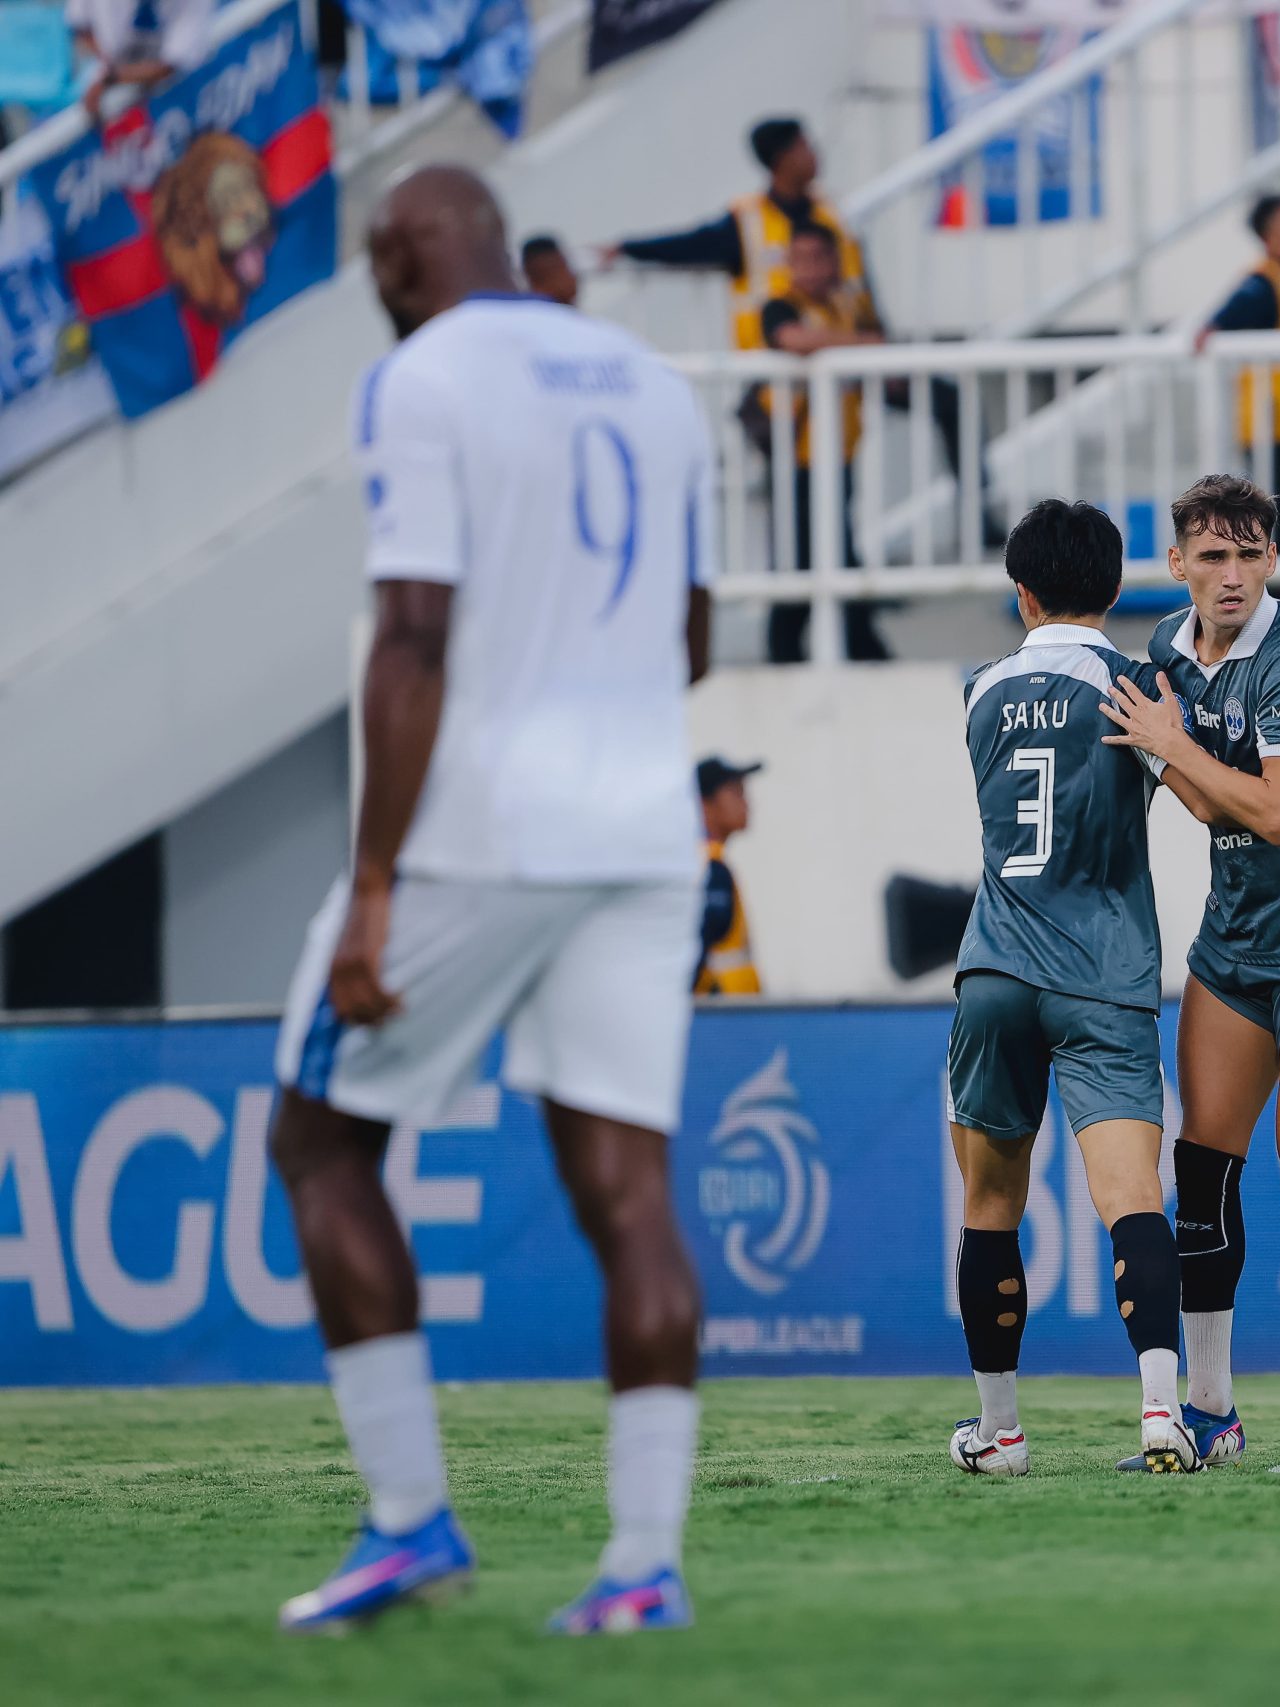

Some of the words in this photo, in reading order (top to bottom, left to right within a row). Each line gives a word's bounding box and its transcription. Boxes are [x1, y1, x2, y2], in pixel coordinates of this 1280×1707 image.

[573, 415, 637, 622] 9
[1002, 699, 1069, 732] SAKU
[1000, 747, 1055, 878] 3
[1213, 832, 1253, 851] xona
[1175, 1219, 1214, 1231] pex
